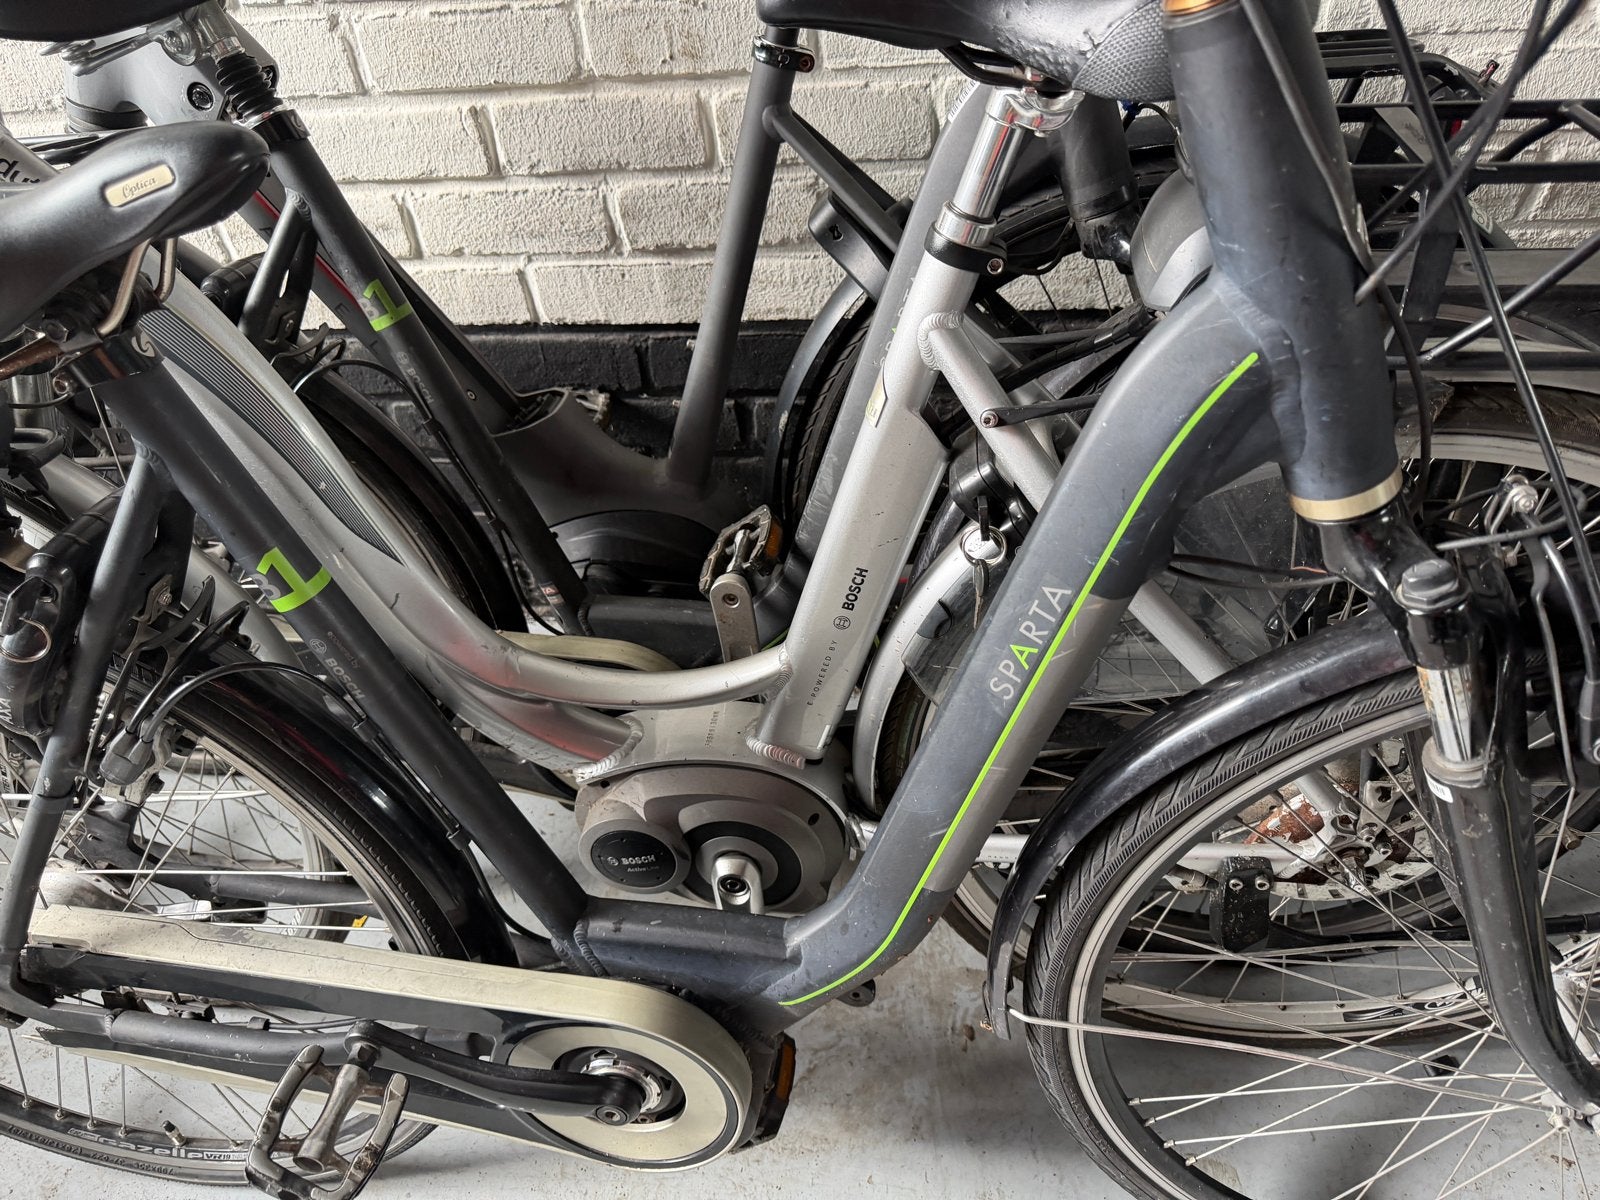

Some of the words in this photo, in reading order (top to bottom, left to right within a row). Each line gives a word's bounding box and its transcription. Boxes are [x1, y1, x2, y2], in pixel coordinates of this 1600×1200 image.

[121, 177, 157, 199] Optica
[842, 567, 869, 611] BOSCH
[989, 586, 1073, 700] SPARTA
[325, 658, 366, 699] BOSCH
[811, 655, 832, 698] POWERED
[0, 697, 14, 725] AXA
[620, 854, 656, 866] BOSCH
